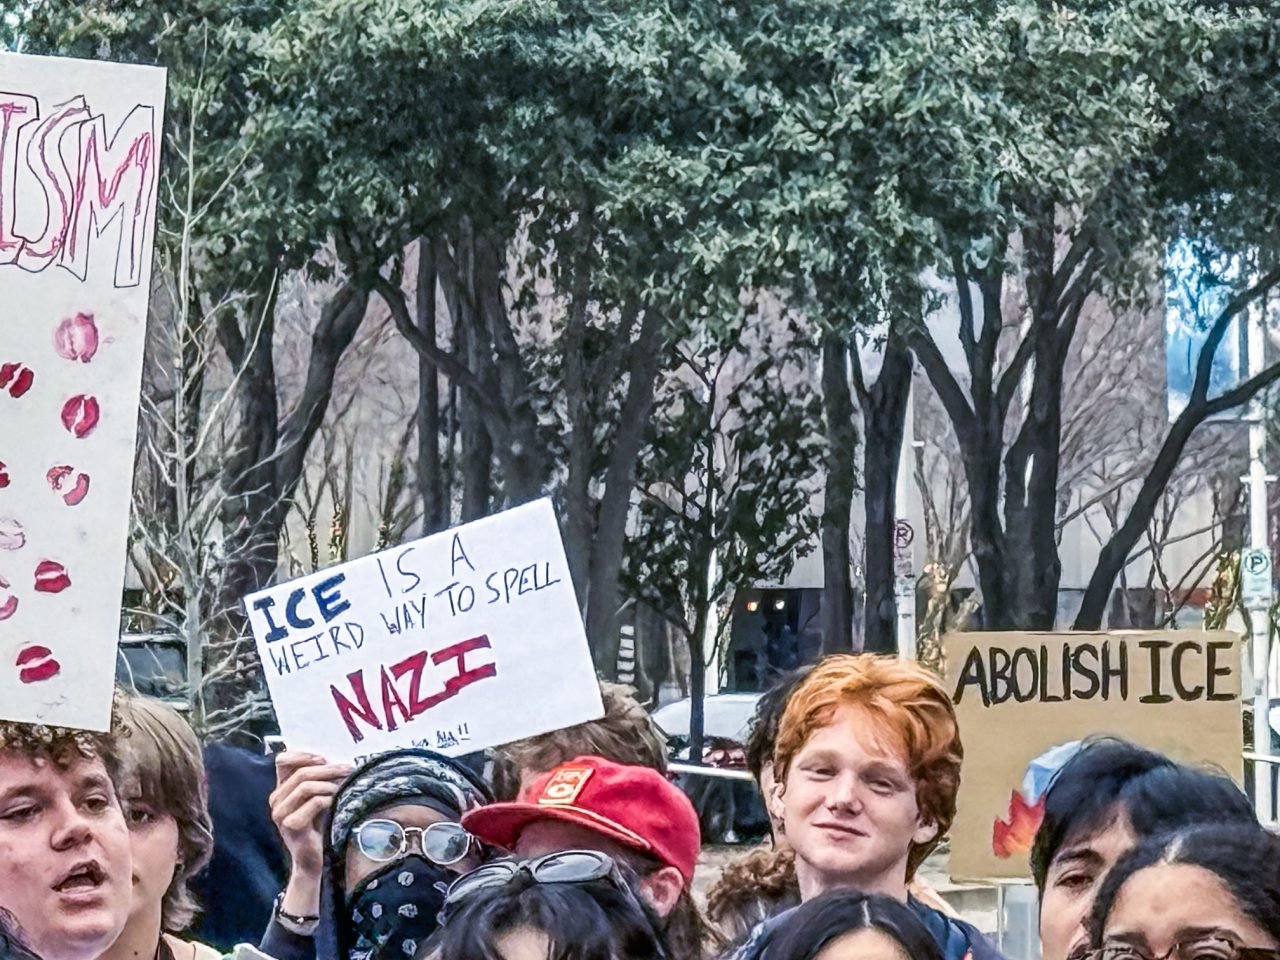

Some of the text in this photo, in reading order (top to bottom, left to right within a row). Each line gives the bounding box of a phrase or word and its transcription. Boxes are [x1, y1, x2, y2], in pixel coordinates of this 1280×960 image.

[253, 533, 475, 644] ICE IS A
[268, 562, 561, 676] WEIRD WAY TO SPELL
[330, 634, 497, 744] NAZI
[953, 640, 1238, 708] ABOLISH ICE
